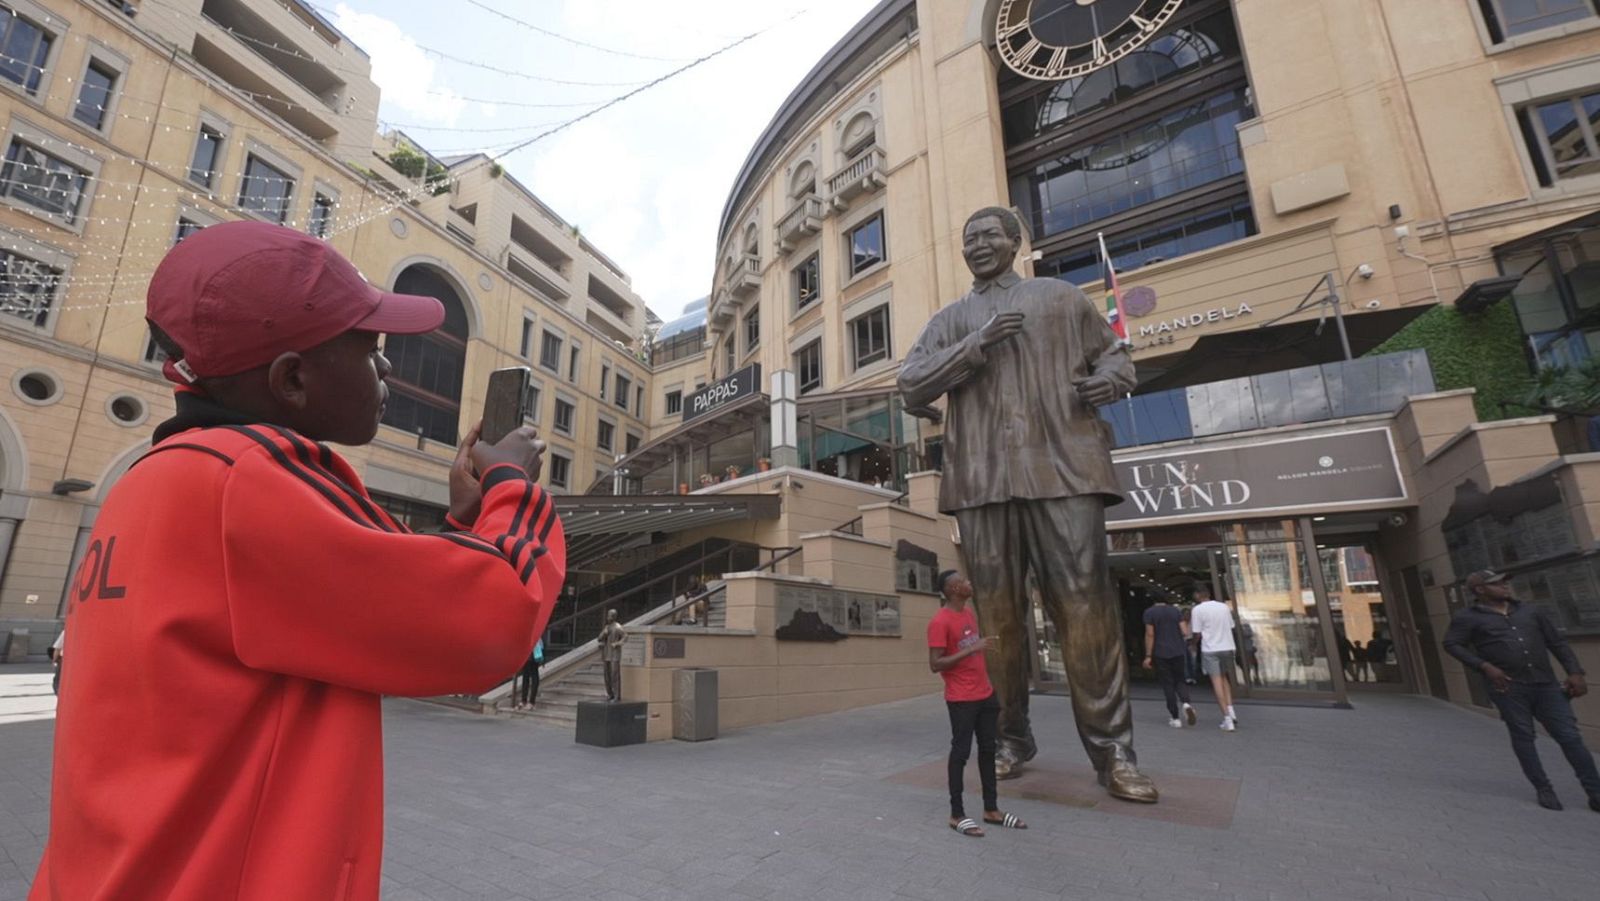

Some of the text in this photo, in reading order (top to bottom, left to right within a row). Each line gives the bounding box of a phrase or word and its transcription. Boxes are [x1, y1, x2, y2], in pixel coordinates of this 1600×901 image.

[1140, 302, 1253, 337] MANDELA
[693, 377, 739, 413] PAPPAS
[1126, 479, 1252, 514] WIND
